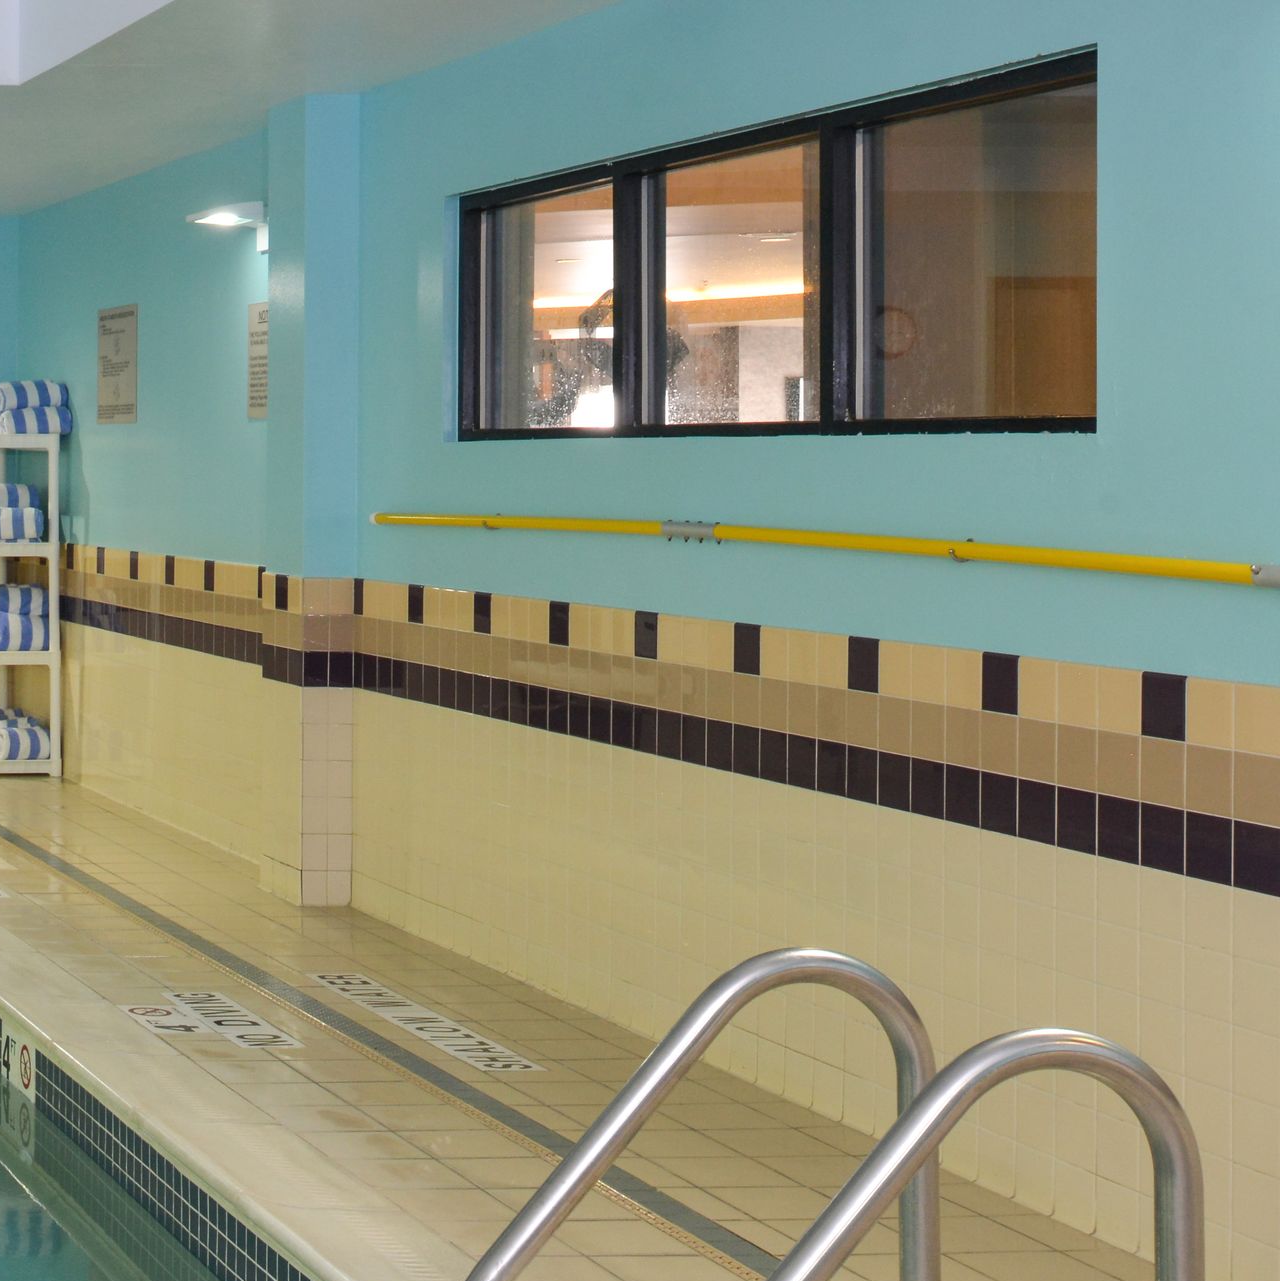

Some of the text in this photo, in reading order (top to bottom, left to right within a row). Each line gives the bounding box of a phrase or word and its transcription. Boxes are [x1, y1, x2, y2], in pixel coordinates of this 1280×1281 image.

[172, 992, 261, 1027] DIVING
[317, 974, 534, 1070] SHALLOW WATER
[2, 1035, 11, 1081] 4
[236, 1033, 294, 1046] NO
